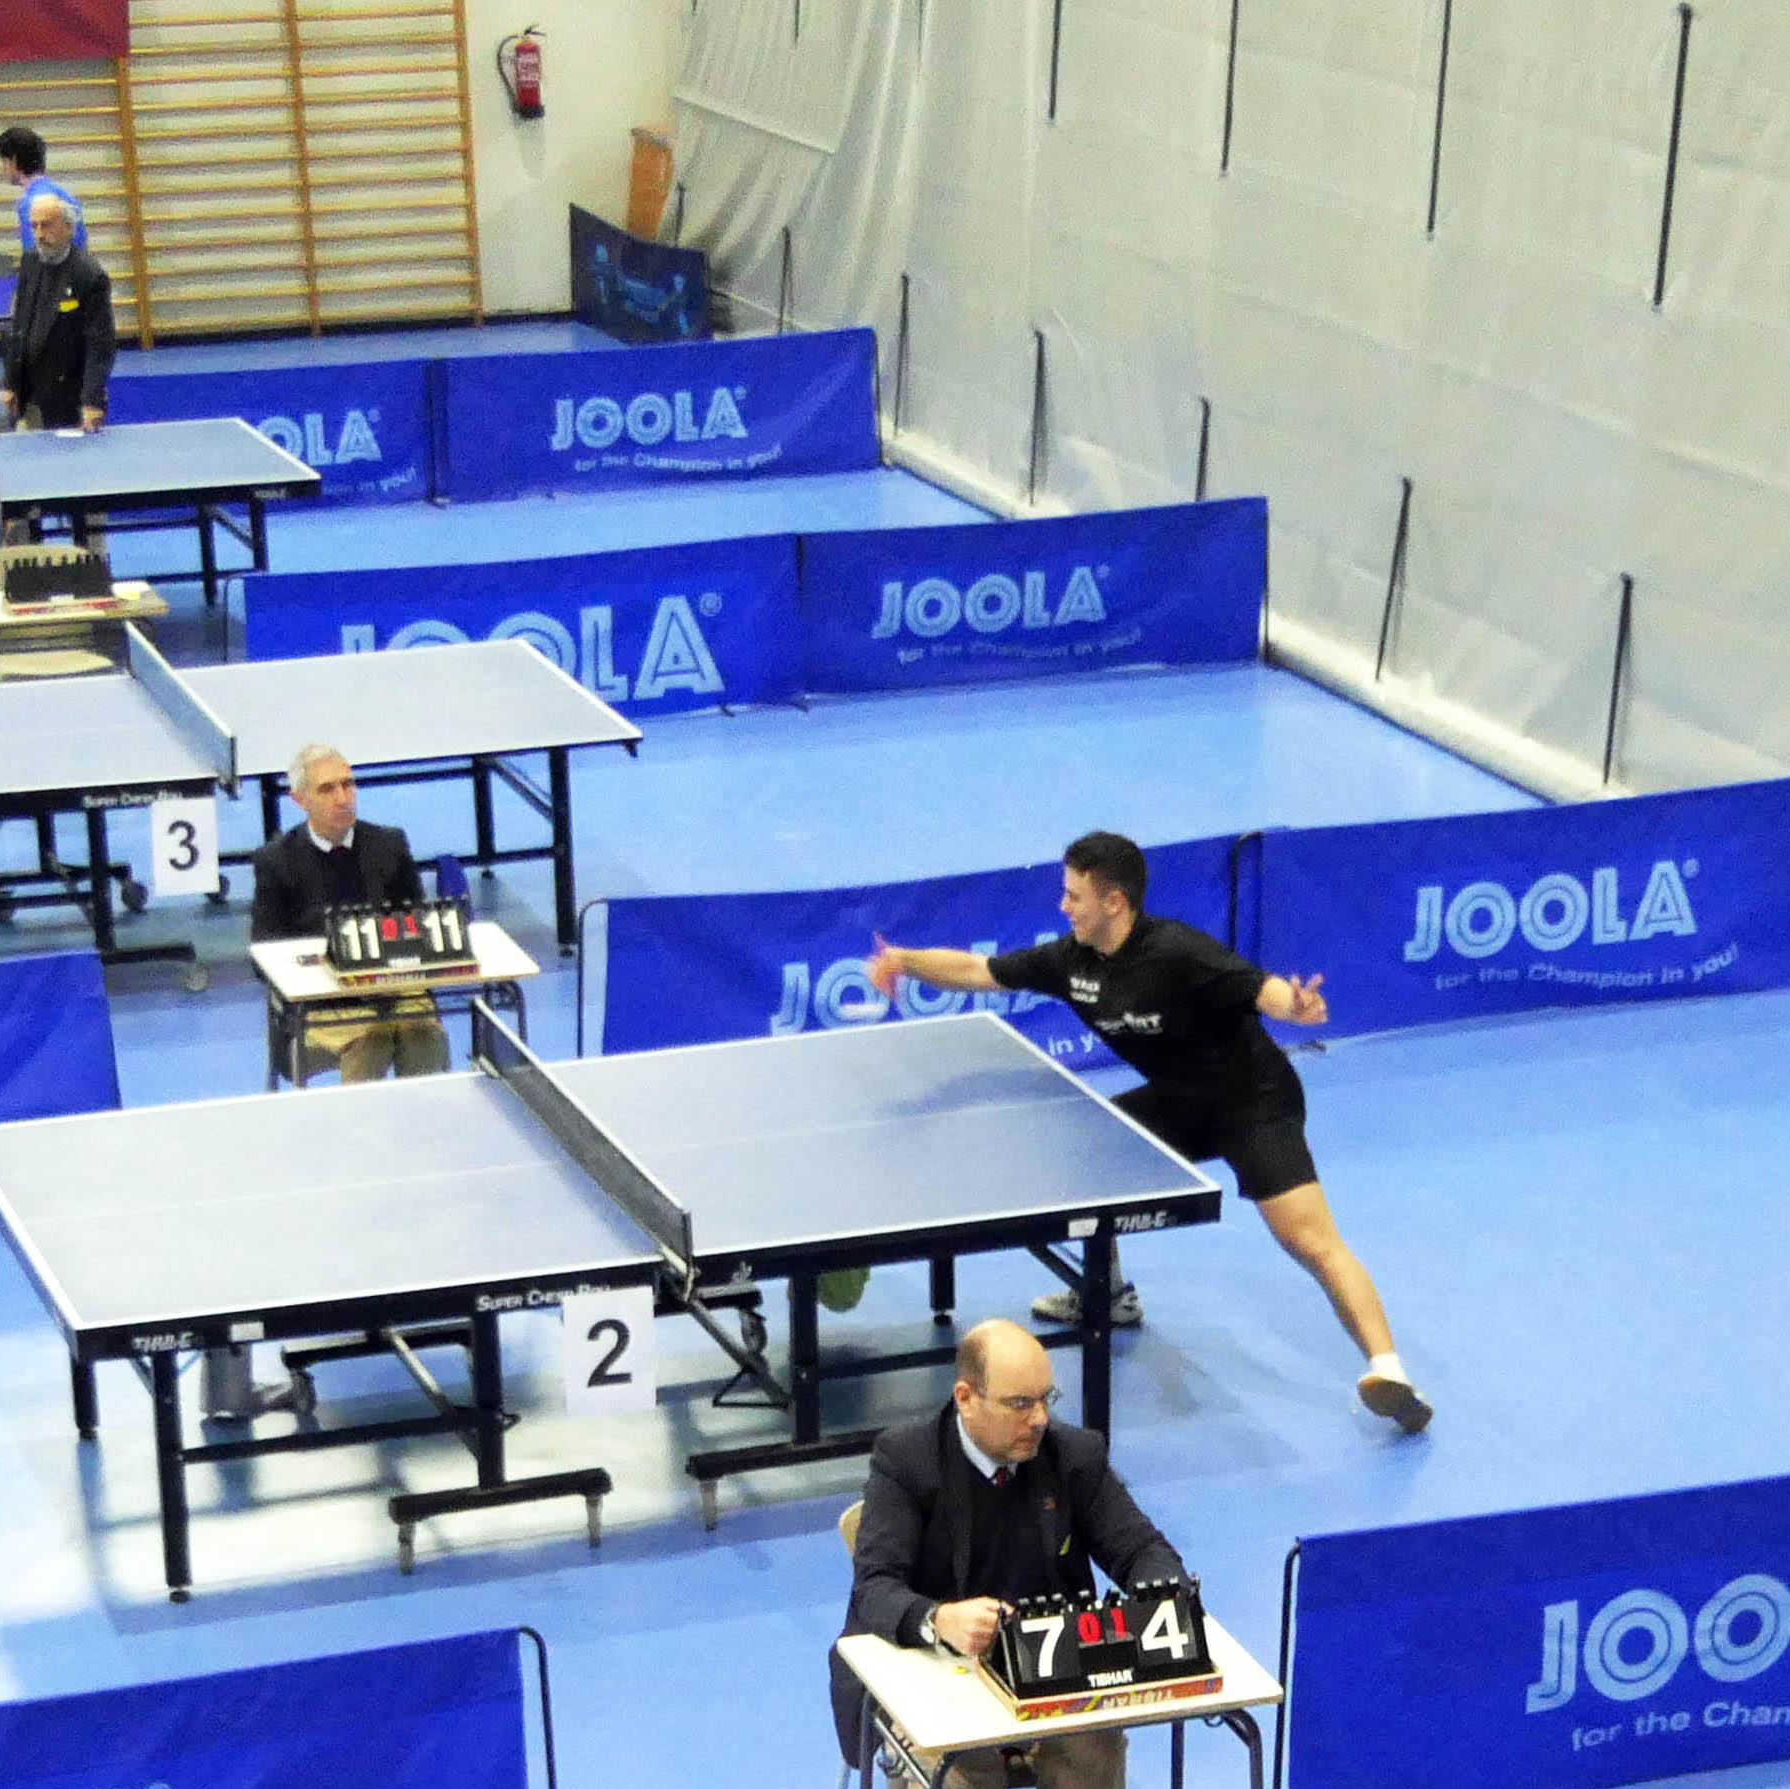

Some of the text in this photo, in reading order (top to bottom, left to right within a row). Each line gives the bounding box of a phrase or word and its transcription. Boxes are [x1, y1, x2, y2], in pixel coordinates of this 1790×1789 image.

[551, 387, 748, 451] JOOLA
[871, 566, 1108, 639] JOOLA
[167, 820, 200, 871] 3
[341, 917, 380, 961] 11
[422, 909, 462, 952] 11
[1403, 860, 1697, 963] JOOLA
[1434, 942, 1740, 991] for the Champion in you!
[586, 1319, 633, 1389] 2
[1020, 1614, 1066, 1678] 7
[1077, 1611, 1103, 1644] 0
[1141, 1599, 1189, 1660] 4
[1570, 1721, 1622, 1752] for
[1634, 1708, 1692, 1734] the
